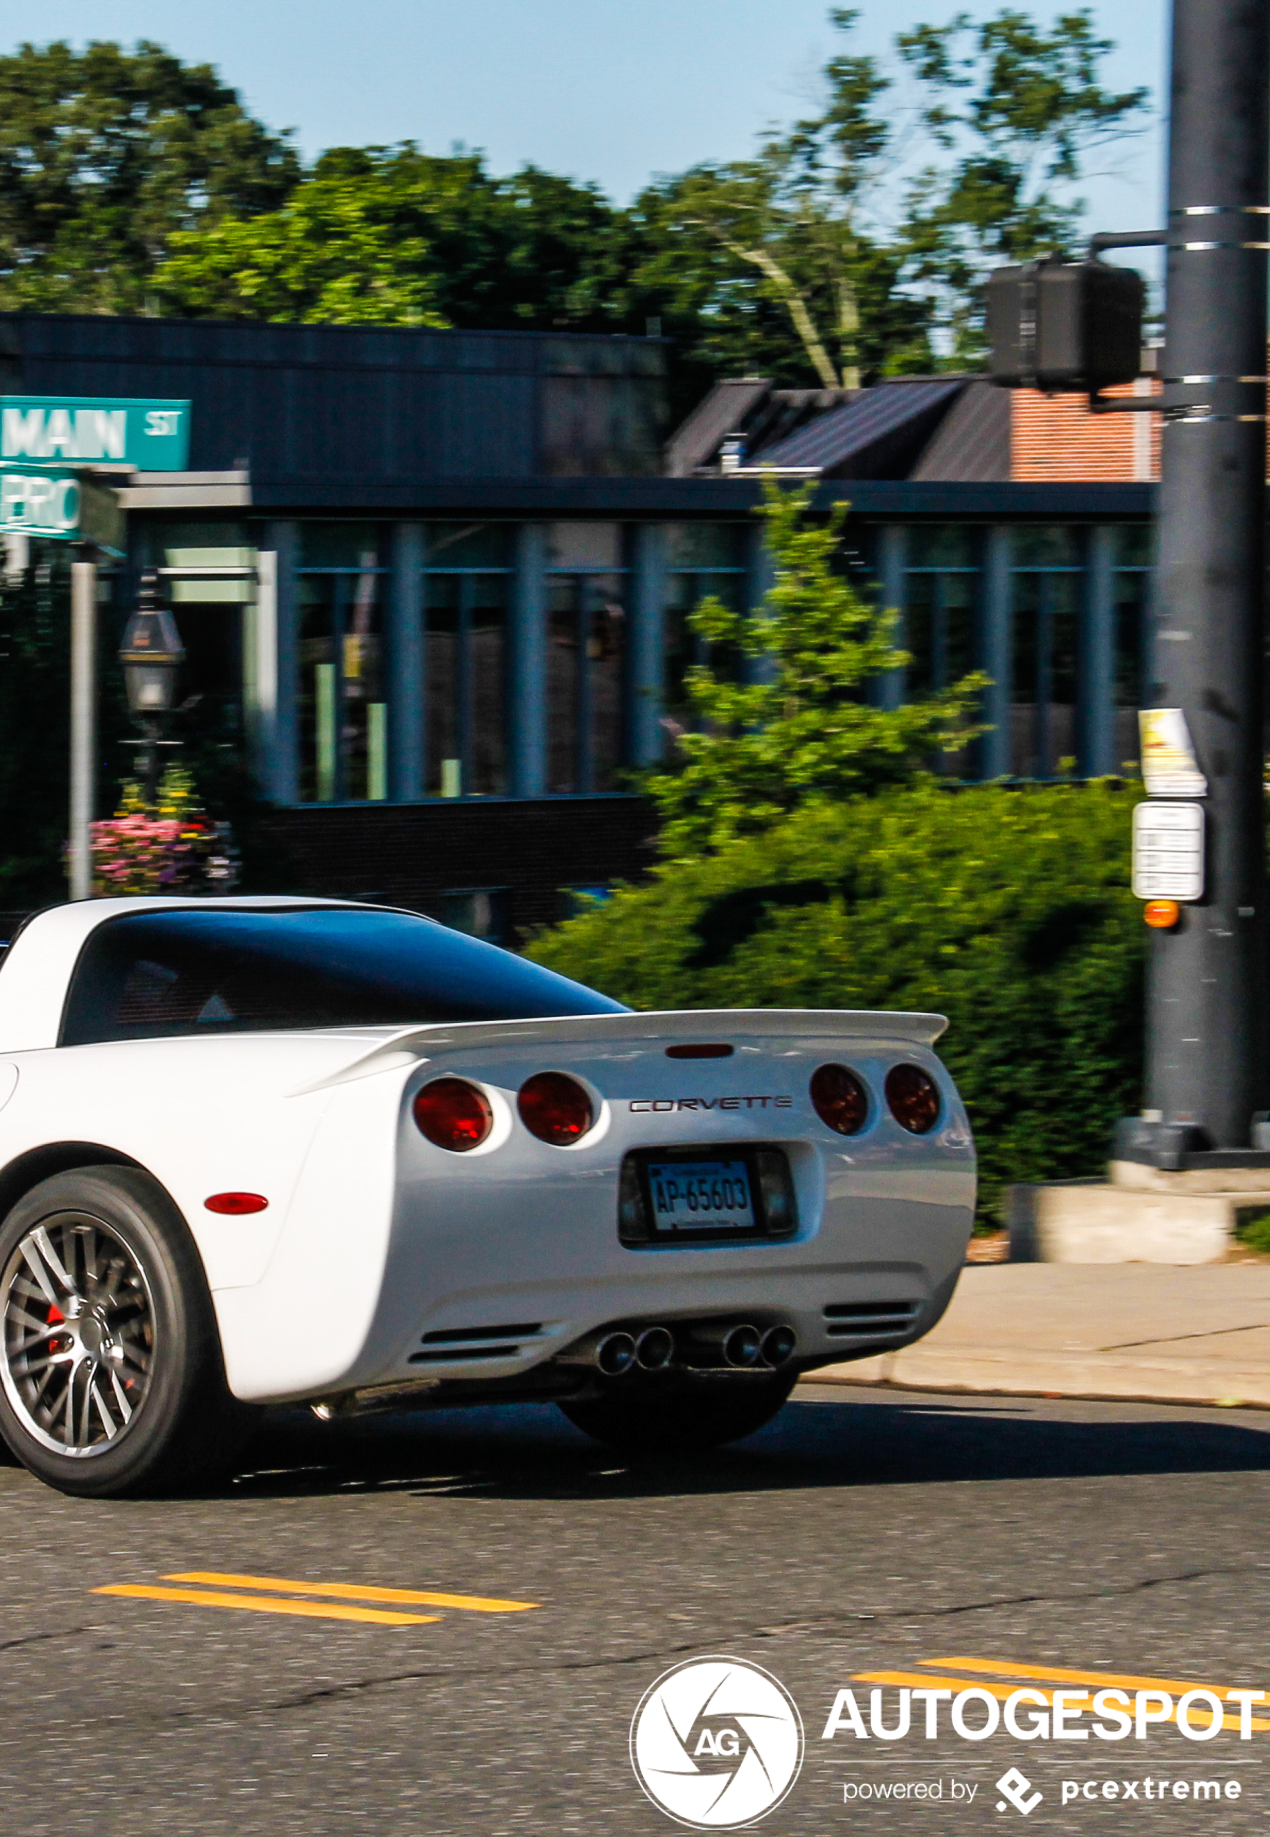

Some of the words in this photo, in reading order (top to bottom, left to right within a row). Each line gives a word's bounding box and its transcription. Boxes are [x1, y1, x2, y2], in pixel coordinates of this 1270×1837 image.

[1, 408, 127, 459] MAIN
[144, 410, 183, 436] ST
[630, 1095, 793, 1113] CORVETTE
